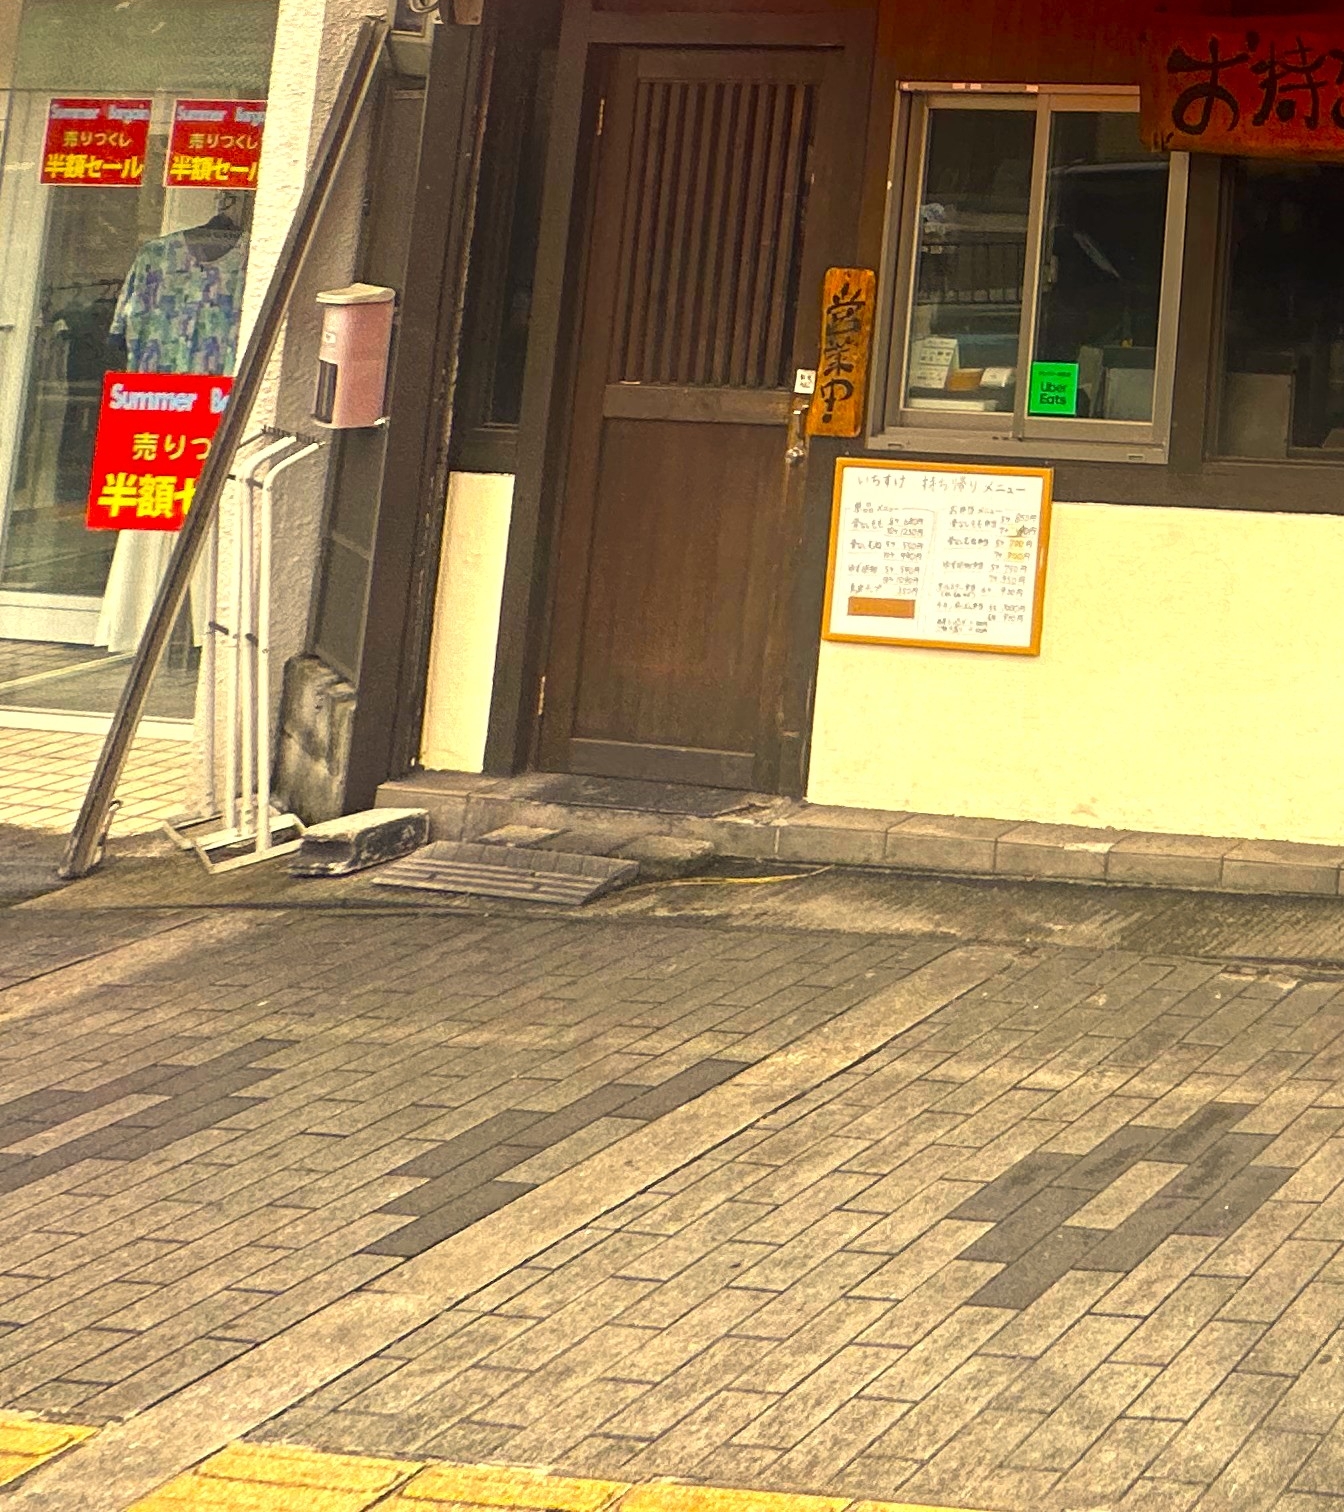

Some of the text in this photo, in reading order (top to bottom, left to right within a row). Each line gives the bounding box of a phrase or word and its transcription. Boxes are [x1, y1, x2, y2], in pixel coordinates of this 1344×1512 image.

[44, 153, 145, 179] 半額セール
[1040, 381, 1067, 393] Uber
[108, 383, 199, 413] Summer
[1039, 392, 1067, 405] Eats
[984, 482, 1027, 494] メニュー
